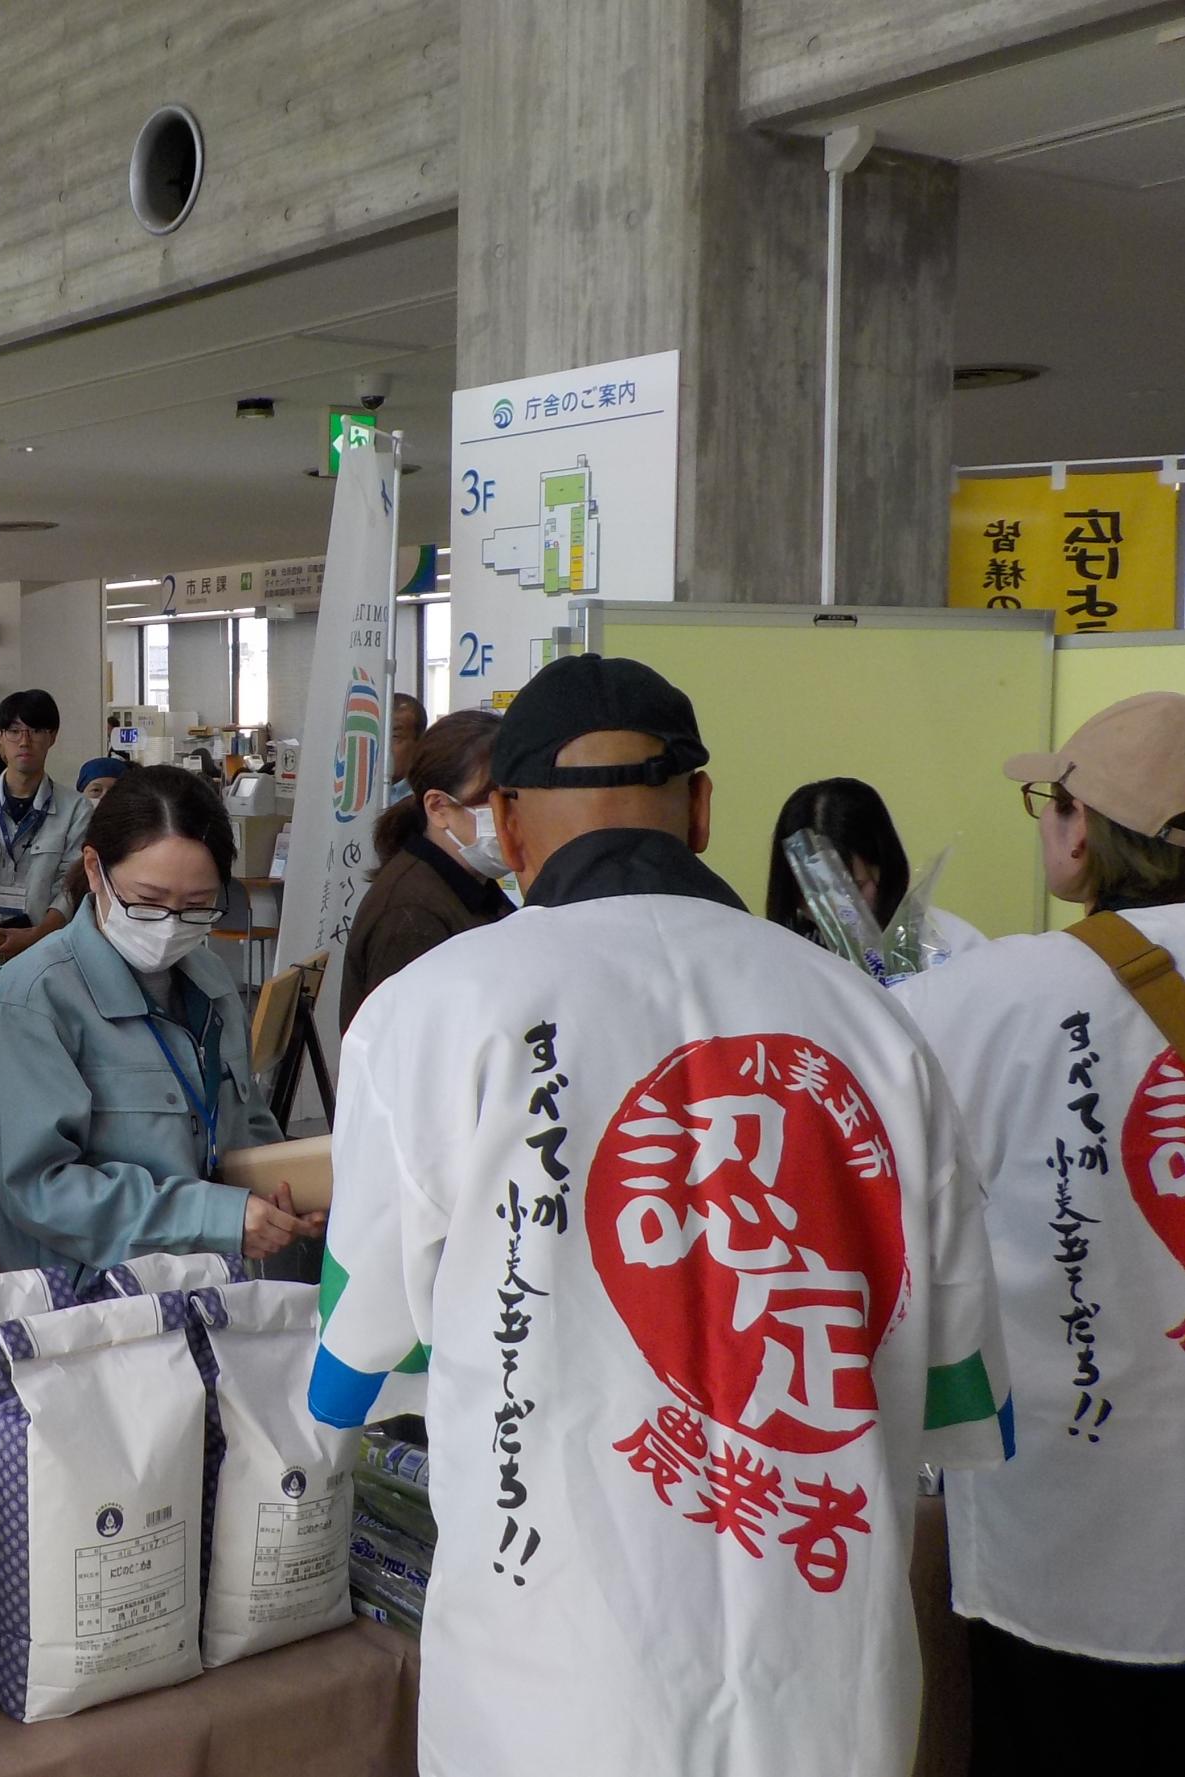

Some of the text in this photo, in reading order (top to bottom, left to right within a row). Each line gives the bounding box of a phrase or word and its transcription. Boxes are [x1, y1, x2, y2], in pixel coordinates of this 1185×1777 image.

[524, 379, 636, 421] 庁舎のご案内
[459, 468, 496, 516] 3F
[161, 574, 228, 616] 2 市民課
[458, 632, 495, 678] 2F
[524, 1020, 571, 1235] すべてが
[738, 1041, 894, 1181] 小美玉市
[1059, 1010, 1109, 1176] すべてが
[615, 1093, 880, 1433] 認定
[612, 1403, 873, 1593] 農業者
